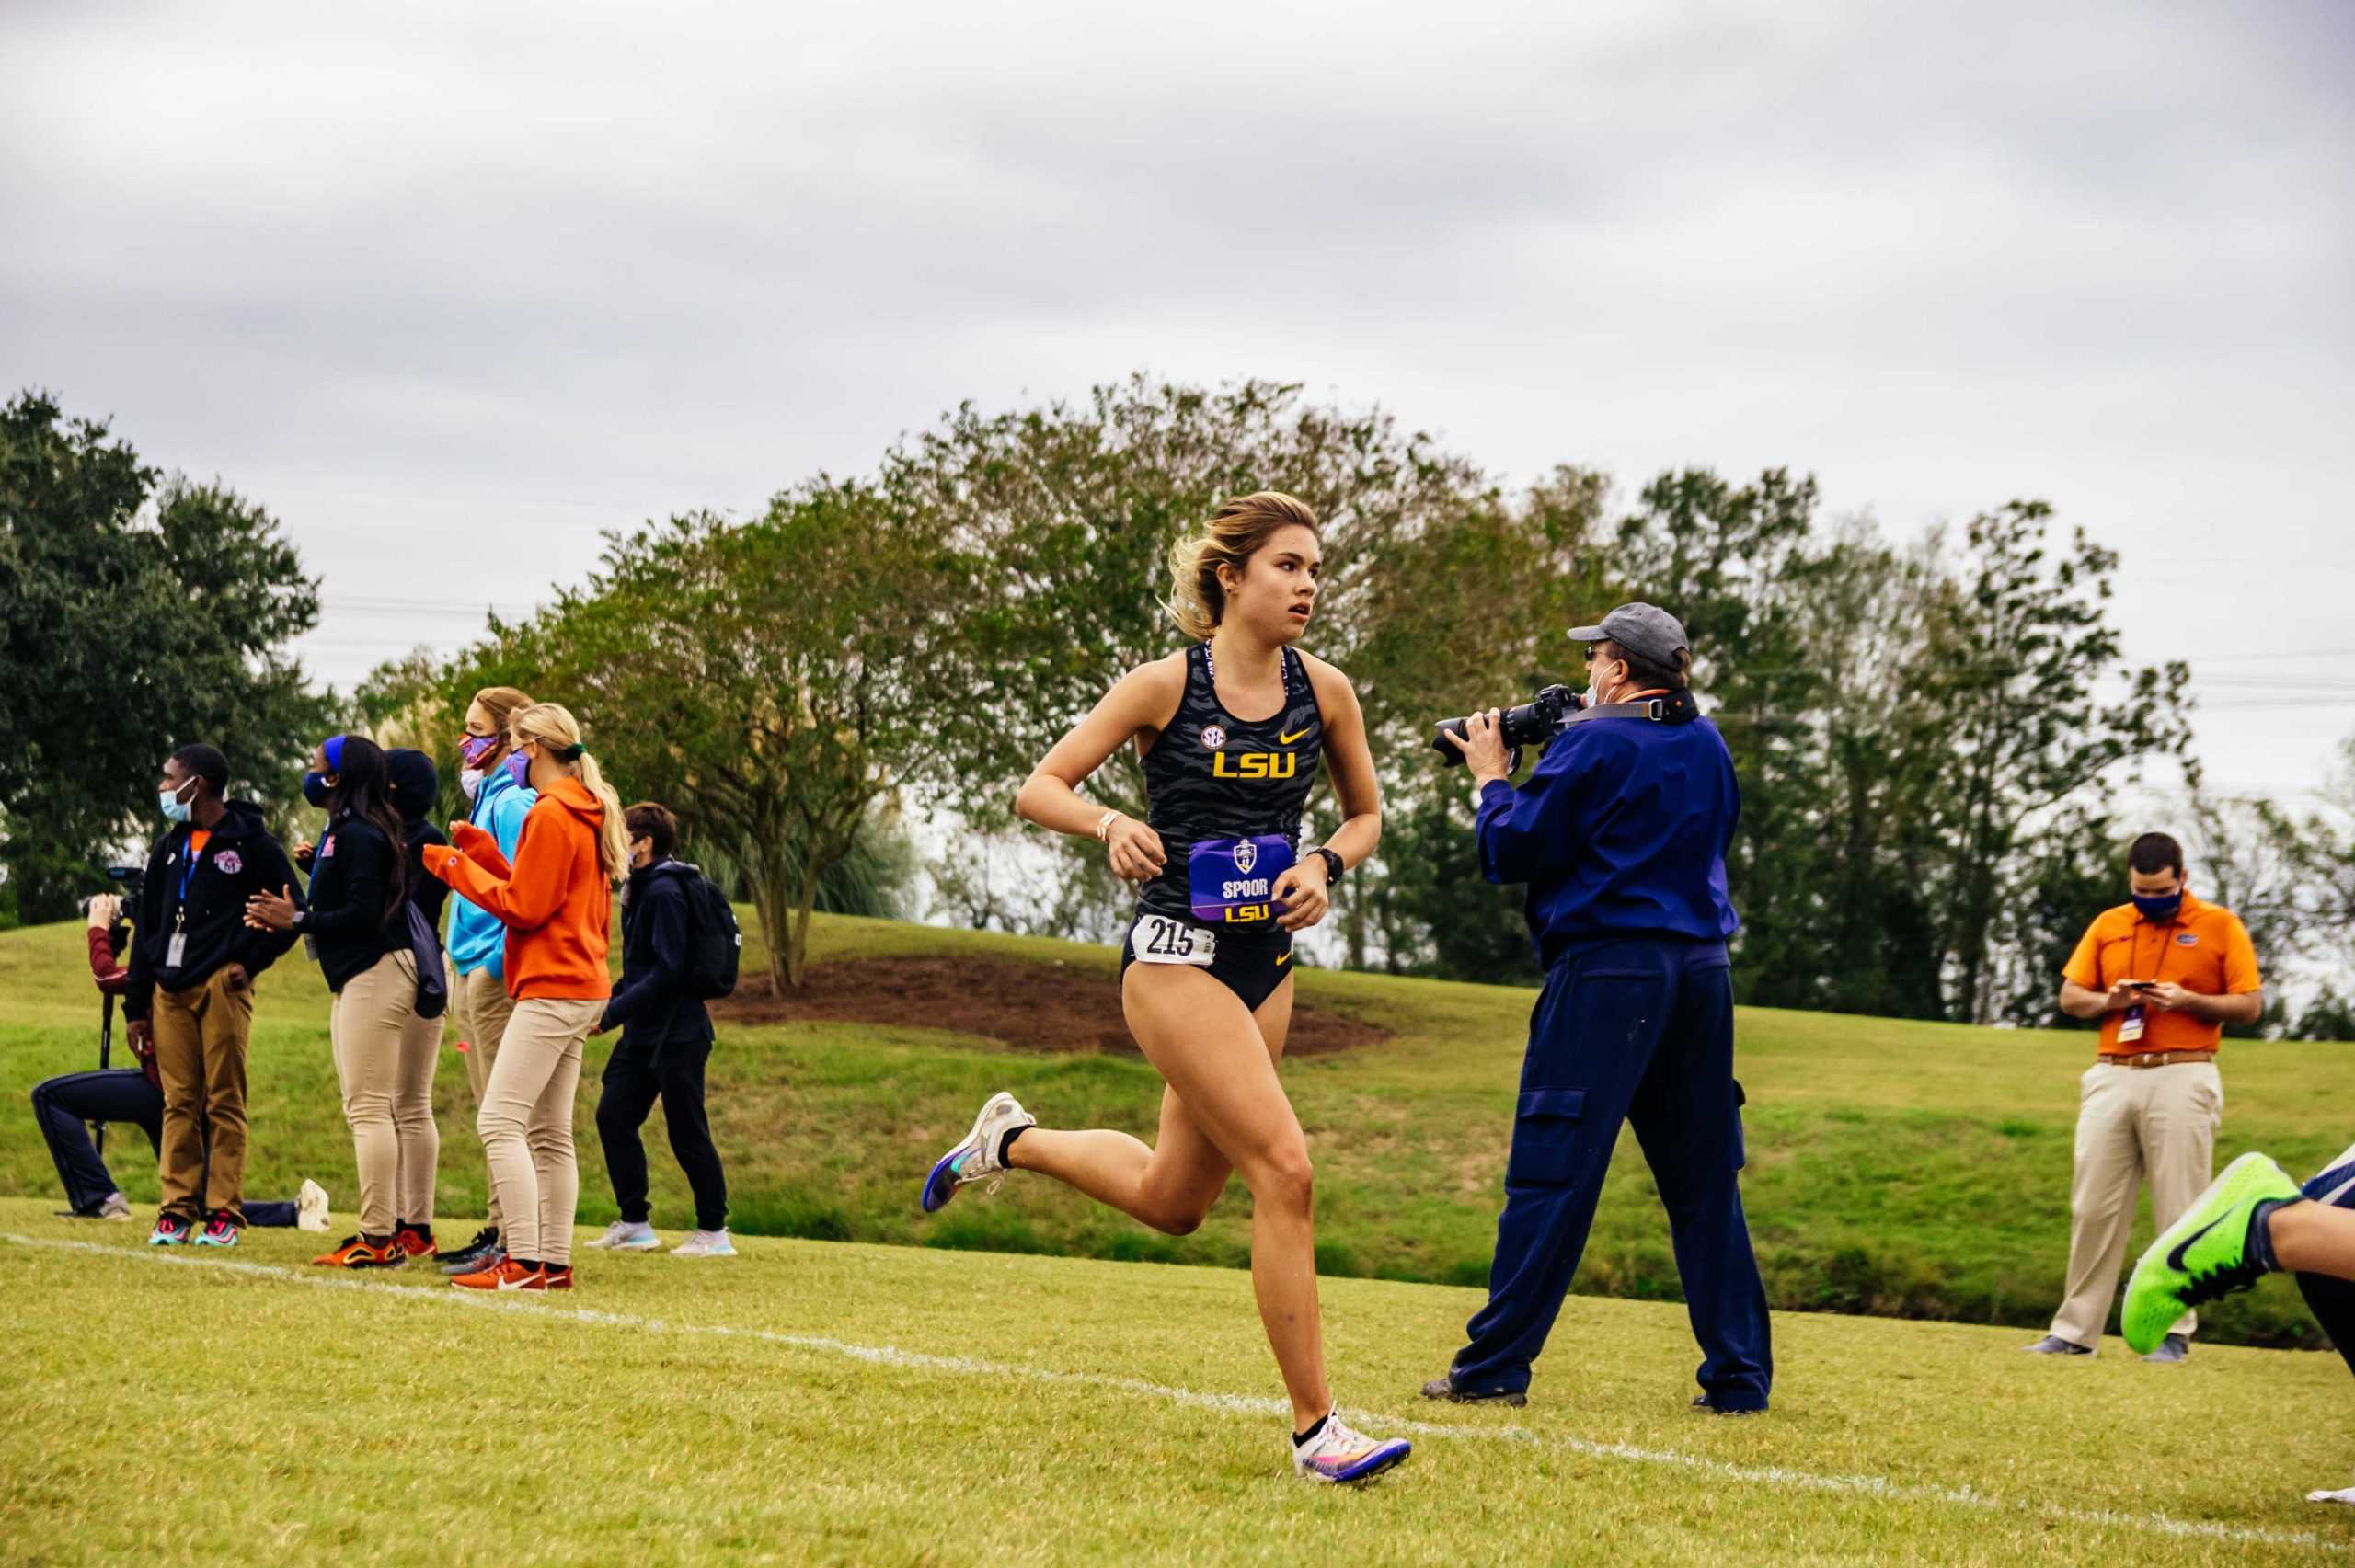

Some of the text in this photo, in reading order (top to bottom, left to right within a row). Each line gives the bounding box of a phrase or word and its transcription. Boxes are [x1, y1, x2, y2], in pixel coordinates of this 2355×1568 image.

[1204, 727, 1225, 747] SEC
[1212, 751, 1296, 779] LSU
[1223, 878, 1269, 898] SPOOR
[1224, 904, 1270, 923] LSU
[1146, 918, 1195, 957] 215
